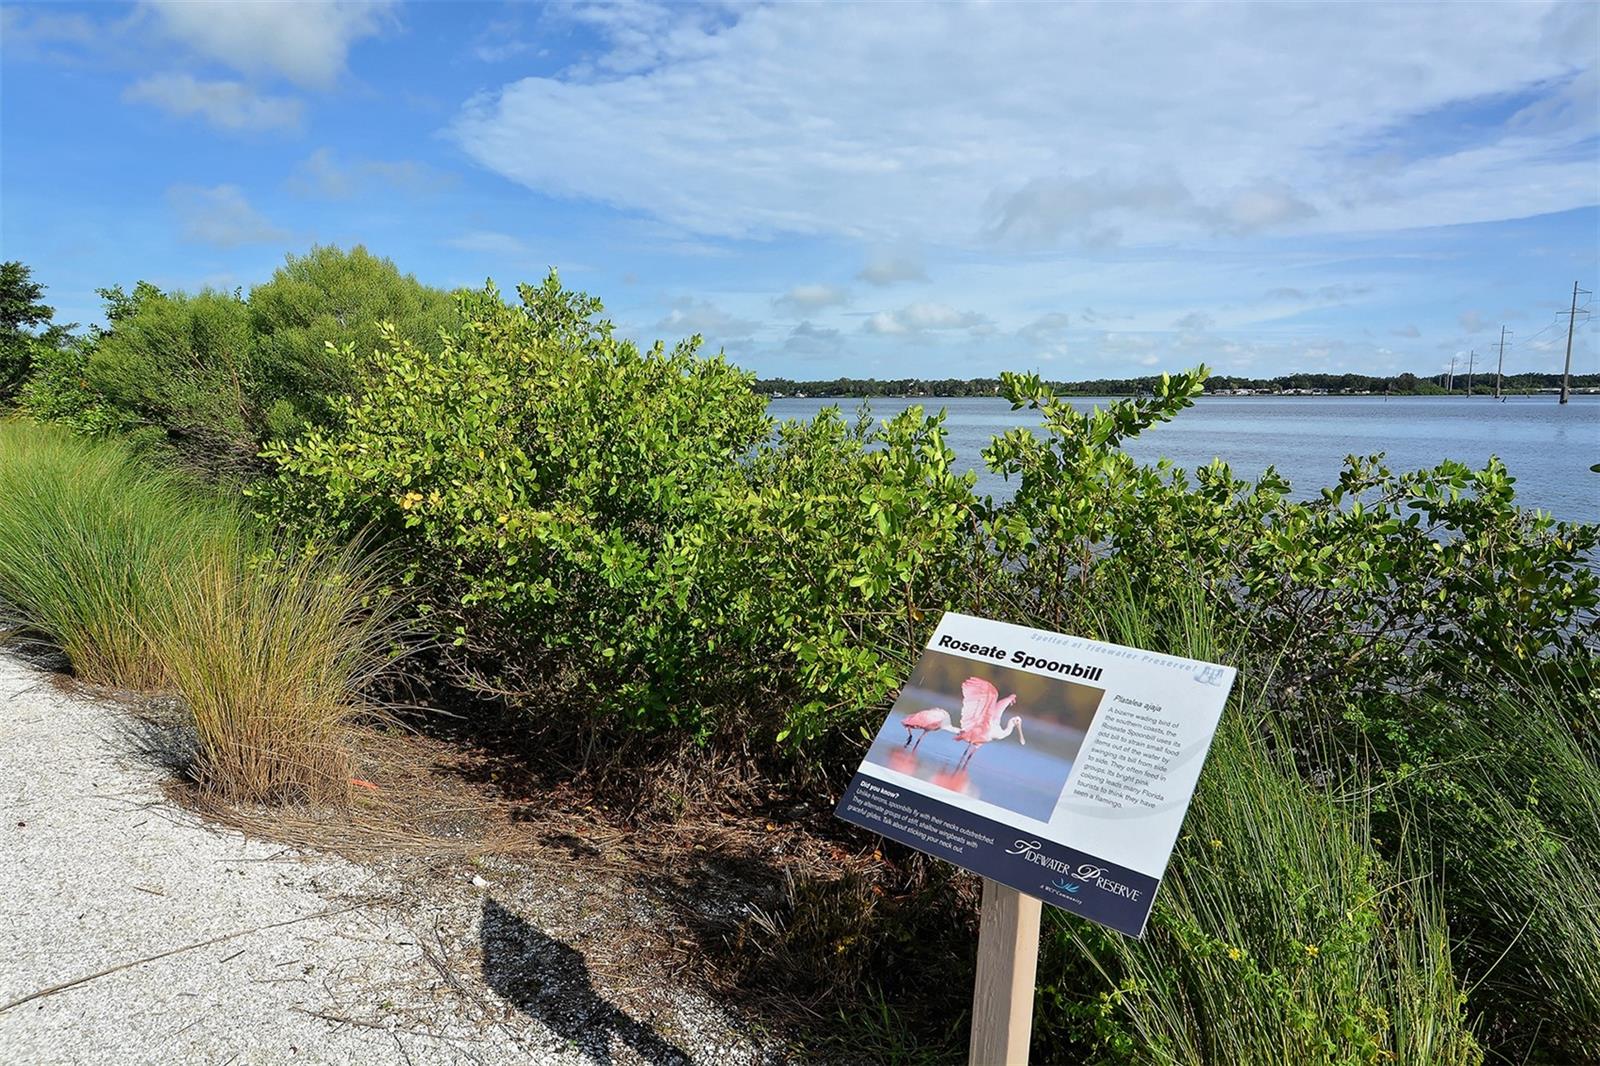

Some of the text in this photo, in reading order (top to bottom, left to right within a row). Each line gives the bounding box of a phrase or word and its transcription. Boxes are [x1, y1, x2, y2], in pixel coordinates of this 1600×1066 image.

[1030, 633, 1068, 646] Spotted
[1086, 644, 1138, 660] Tidewater
[938, 635, 1103, 681] Roseate Spoonbill
[1113, 694, 1162, 712] Platalea ajaja
[1116, 718, 1142, 728] southern
[1136, 714, 1157, 724] wading
[1102, 722, 1126, 733] Roseate
[1127, 729, 1156, 740] Spoonbill
[1156, 738, 1172, 746] uses
[1128, 739, 1146, 748] strain
[1146, 744, 1164, 752] small
[1164, 748, 1180, 756] food
[1143, 752, 1160, 760] water
[1111, 760, 1125, 771] They
[1126, 766, 1143, 775] often
[1144, 771, 1159, 780] feed
[1127, 756, 1137, 764] bill
[1138, 759, 1152, 767] from
[1154, 764, 1168, 772] side
[1080, 772, 1164, 801] coloring leads many Florida
[1116, 772, 1134, 782] bright
[1135, 778, 1148, 787] pink
[860, 780, 870, 789] Did
[880, 788, 900, 799] know?
[1073, 789, 1089, 798] seen
[1077, 780, 1099, 791] tourists
[1108, 789, 1123, 798] think
[1124, 794, 1138, 805] they
[1139, 799, 1156, 809] have
[1004, 840, 1140, 902] TIDEWATER PRESERVE
